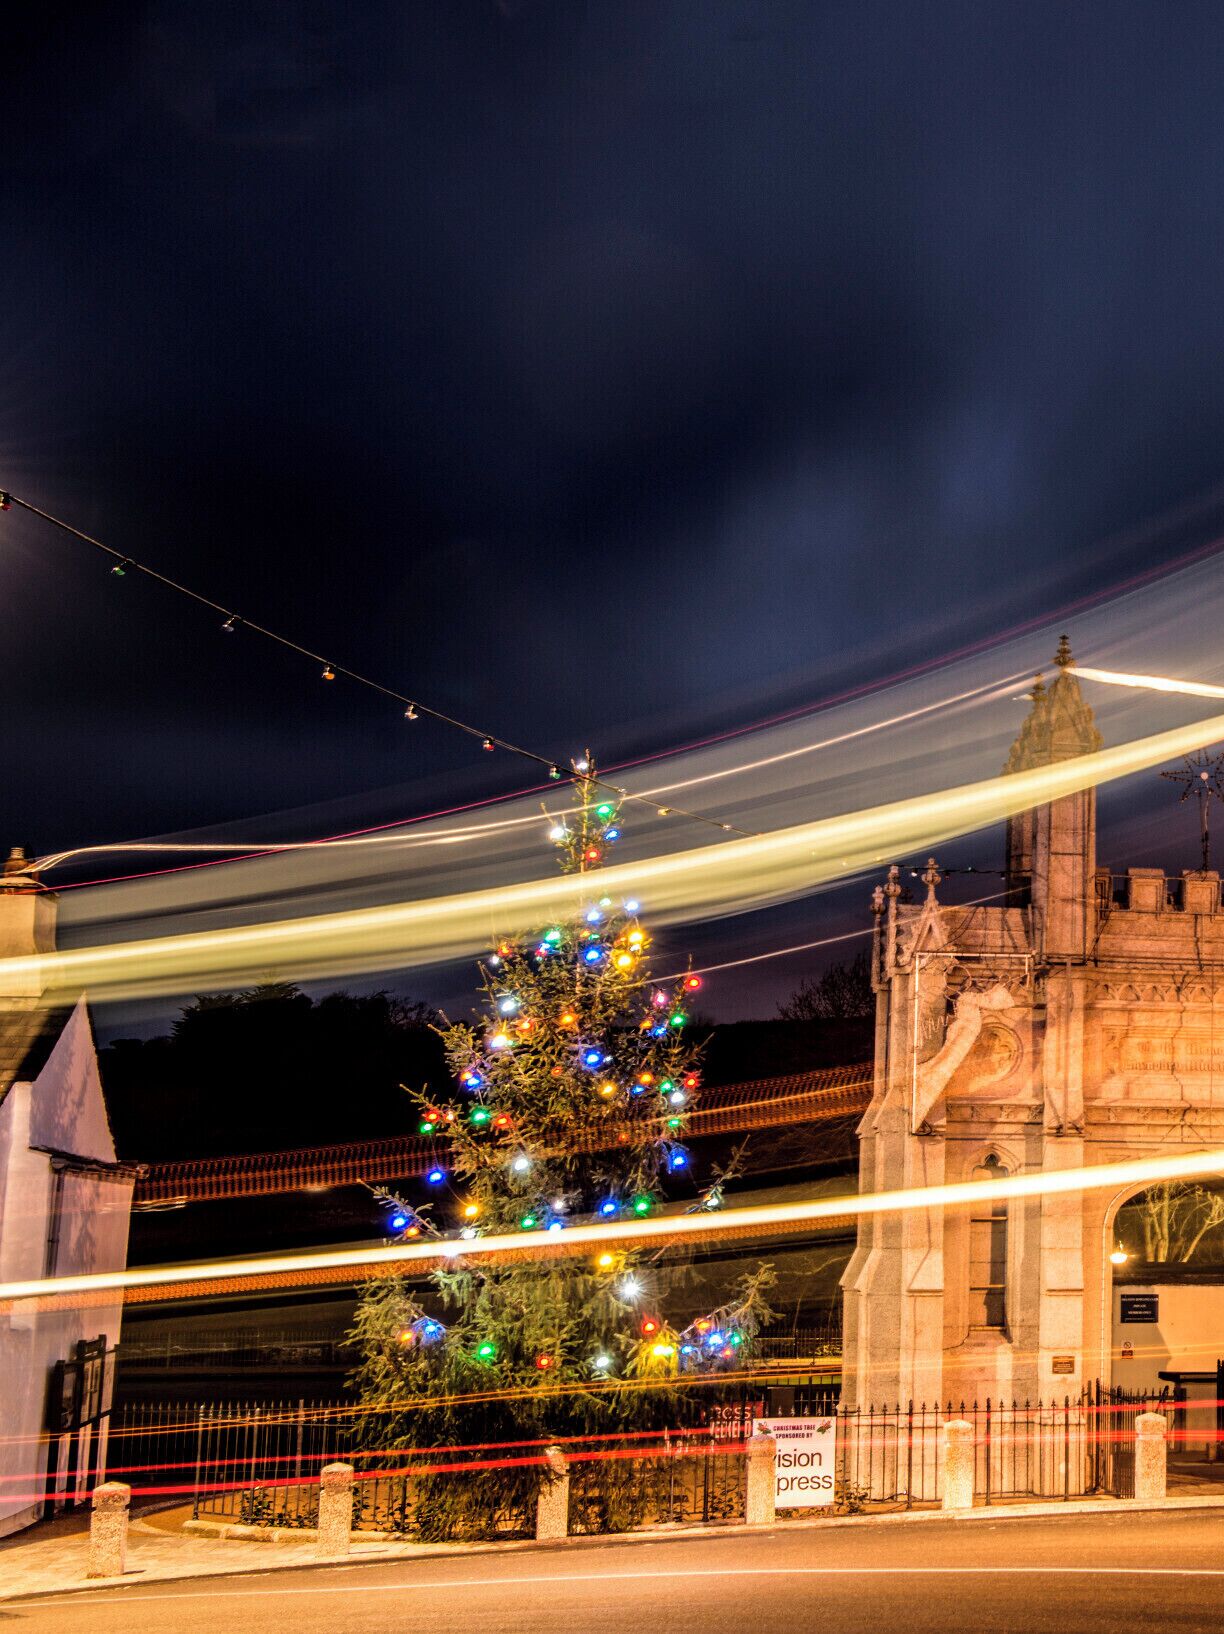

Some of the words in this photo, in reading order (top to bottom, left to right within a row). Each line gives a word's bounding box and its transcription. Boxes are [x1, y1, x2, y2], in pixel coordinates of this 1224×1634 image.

[773, 1424, 803, 1432] CHRISTMAS
[775, 1432, 806, 1440] SPONSORED
[773, 1448, 822, 1468] ision
[776, 1474, 833, 1496] press
